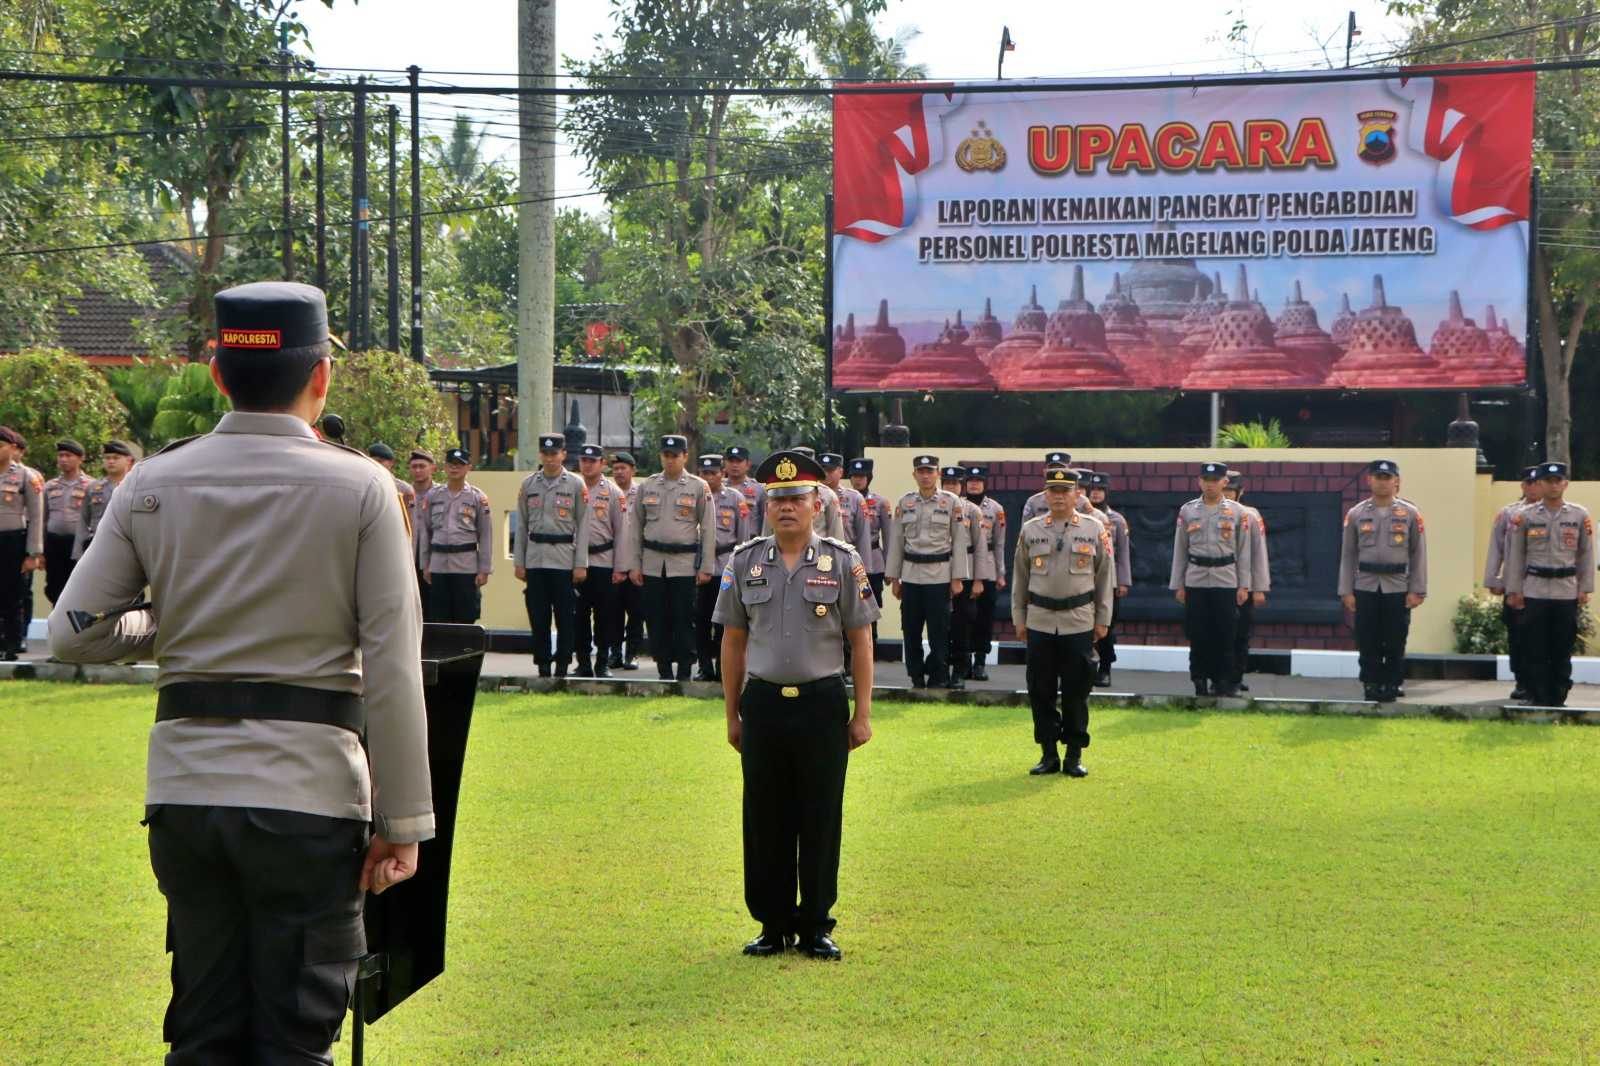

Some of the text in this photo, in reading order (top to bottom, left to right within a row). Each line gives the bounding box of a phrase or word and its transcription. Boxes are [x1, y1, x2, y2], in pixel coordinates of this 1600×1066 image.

[1028, 117, 1336, 176] UPACARA
[938, 189, 1415, 224] LAPORAN KENAIKAN PANGKAT PENGABDIAN
[919, 226, 1434, 260] PERSONEL POLRESTA MAGELANG POLDA JATENG
[223, 332, 277, 345] KAPOLRESTA
